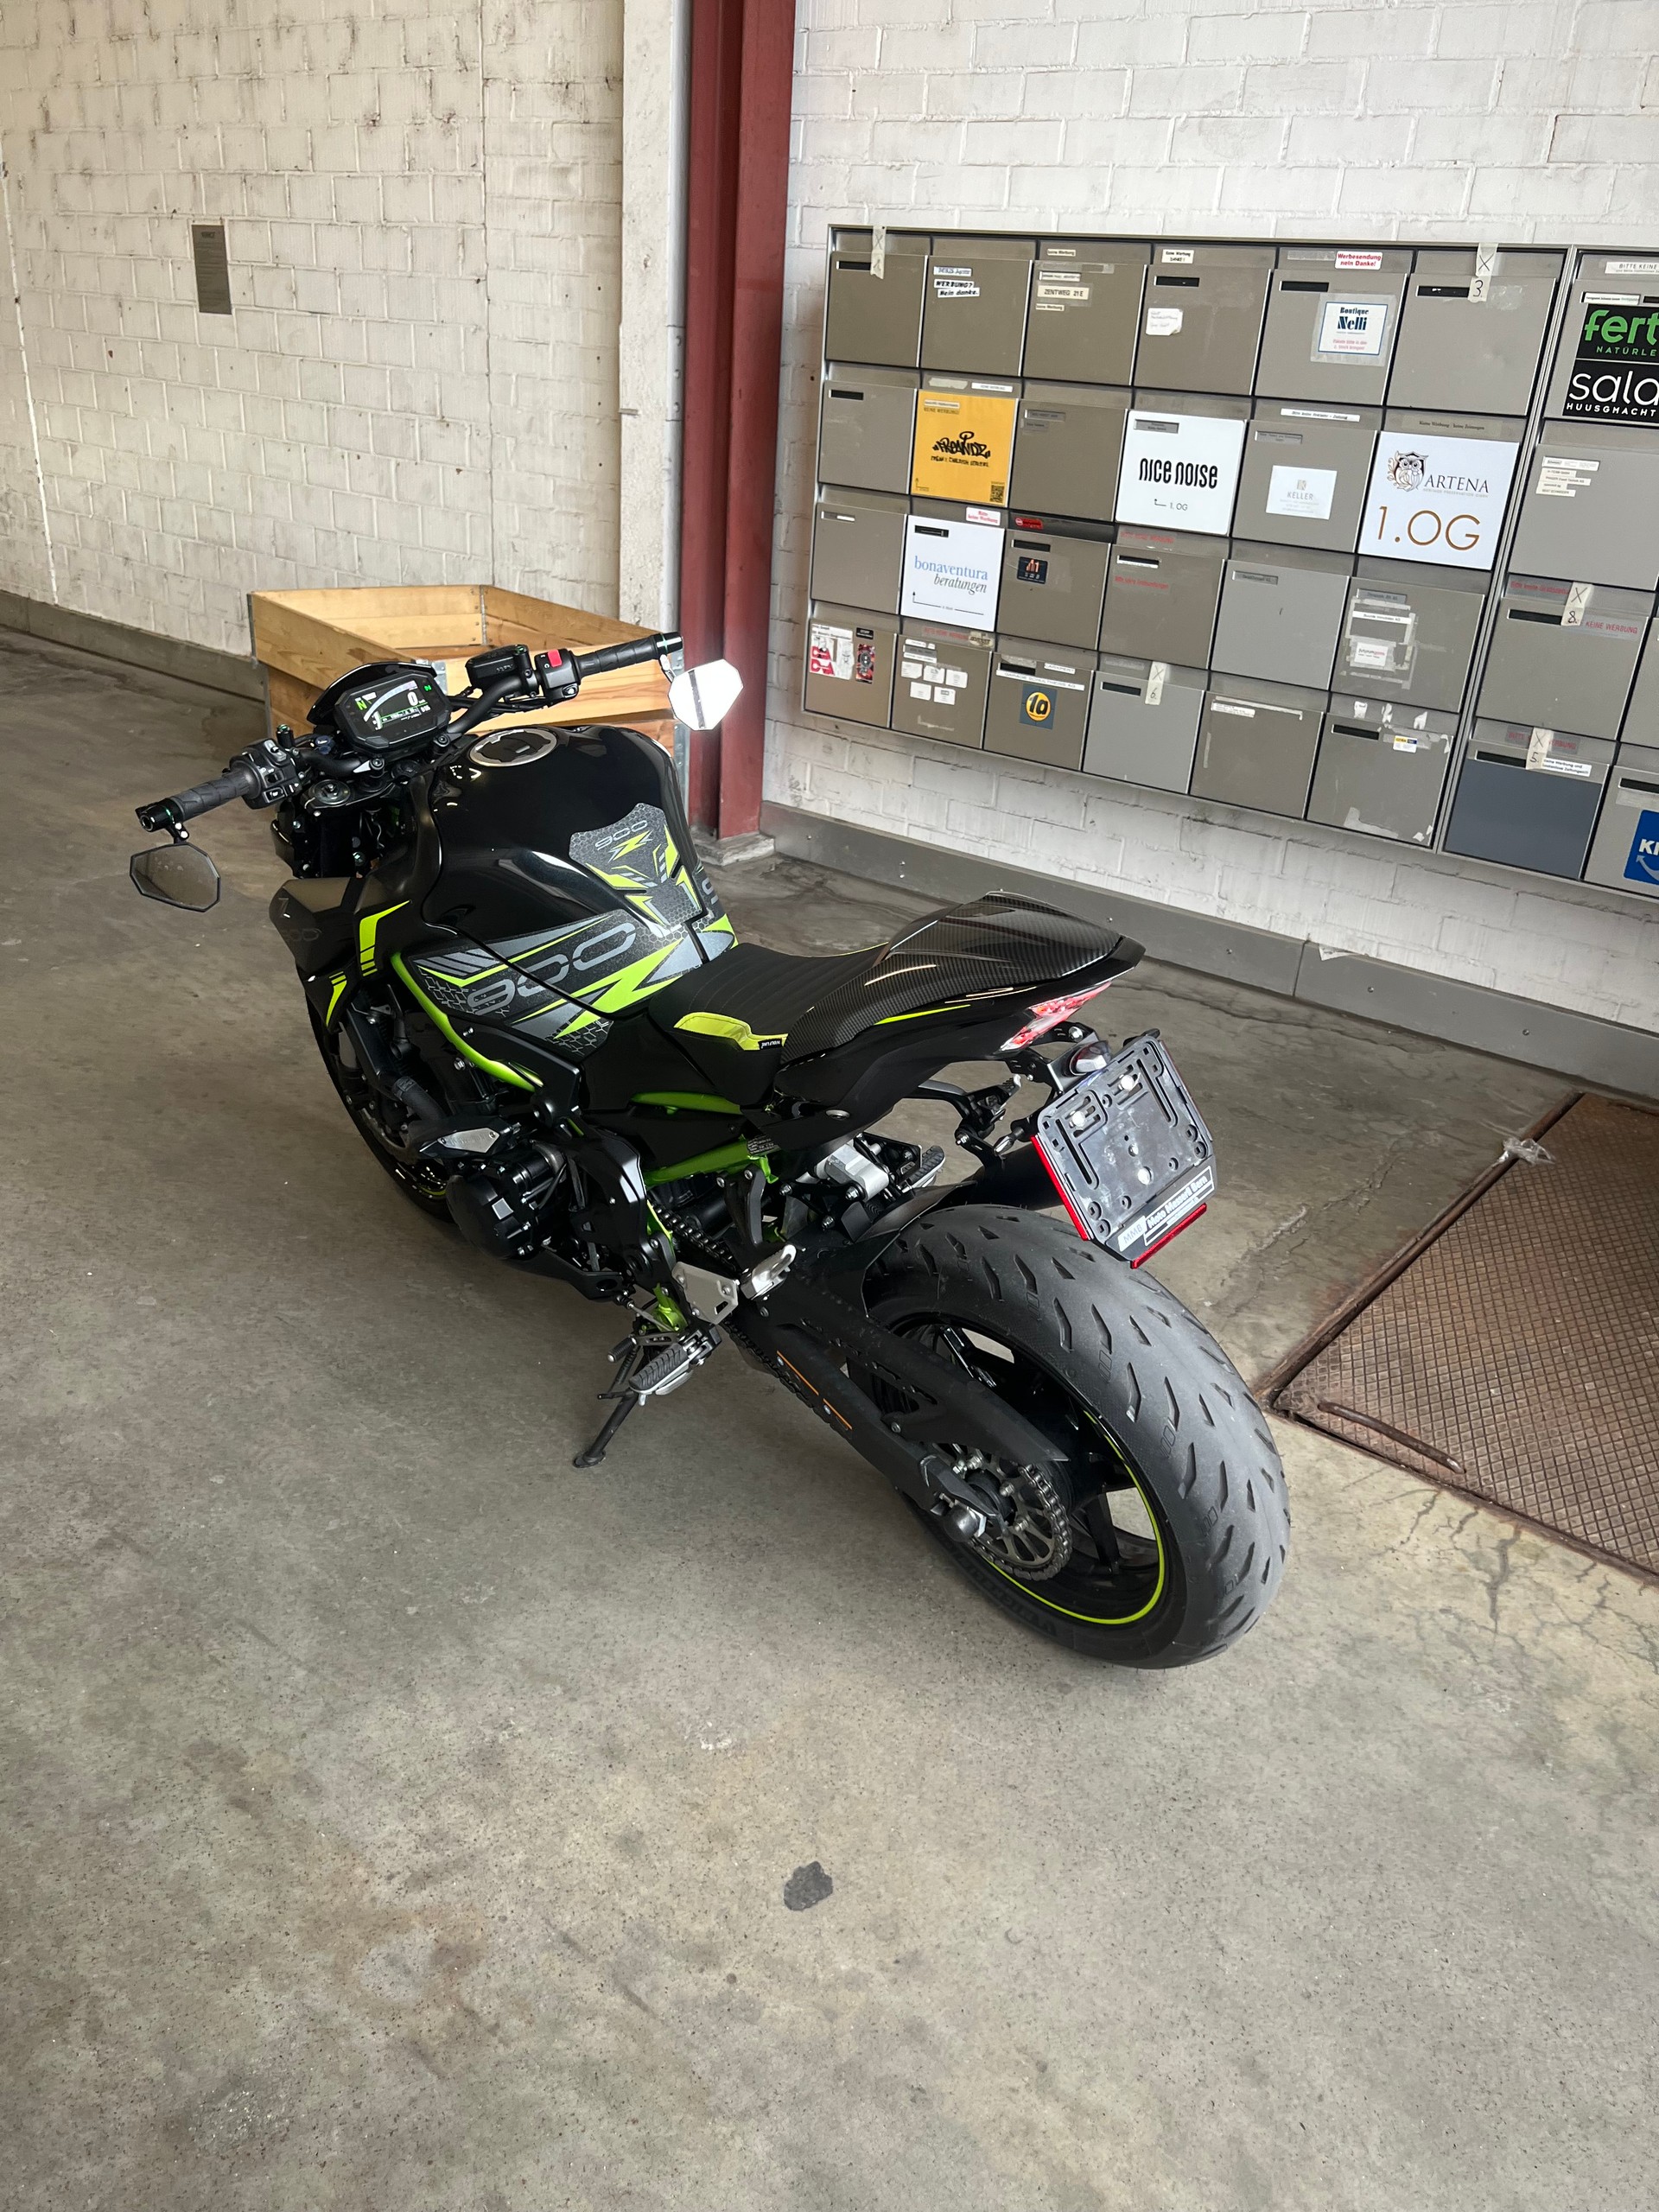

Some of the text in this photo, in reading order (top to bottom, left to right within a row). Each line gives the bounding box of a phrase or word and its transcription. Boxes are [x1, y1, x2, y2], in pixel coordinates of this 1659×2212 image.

[1338, 253, 1382, 262] Werbesendung
[1340, 307, 1370, 316] Boutique
[1337, 316, 1368, 331] Nelli
[1567, 403, 1656, 416] HUUSGMACHT
[1139, 458, 1218, 489] nice noise
[1424, 474, 1489, 493] ARTENA
[1287, 491, 1313, 500] KELLER
[914, 556, 988, 581] bonaventura
[934, 574, 987, 595] beratungen
[1586, 620, 1604, 629] KEINE
[1605, 621, 1638, 634] WERBUNG
[595, 820, 648, 850] 900
[1147, 1210, 1166, 1229] Moto
[1190, 1176, 1208, 1192] Bern
[1123, 1224, 1143, 1244] MMB
